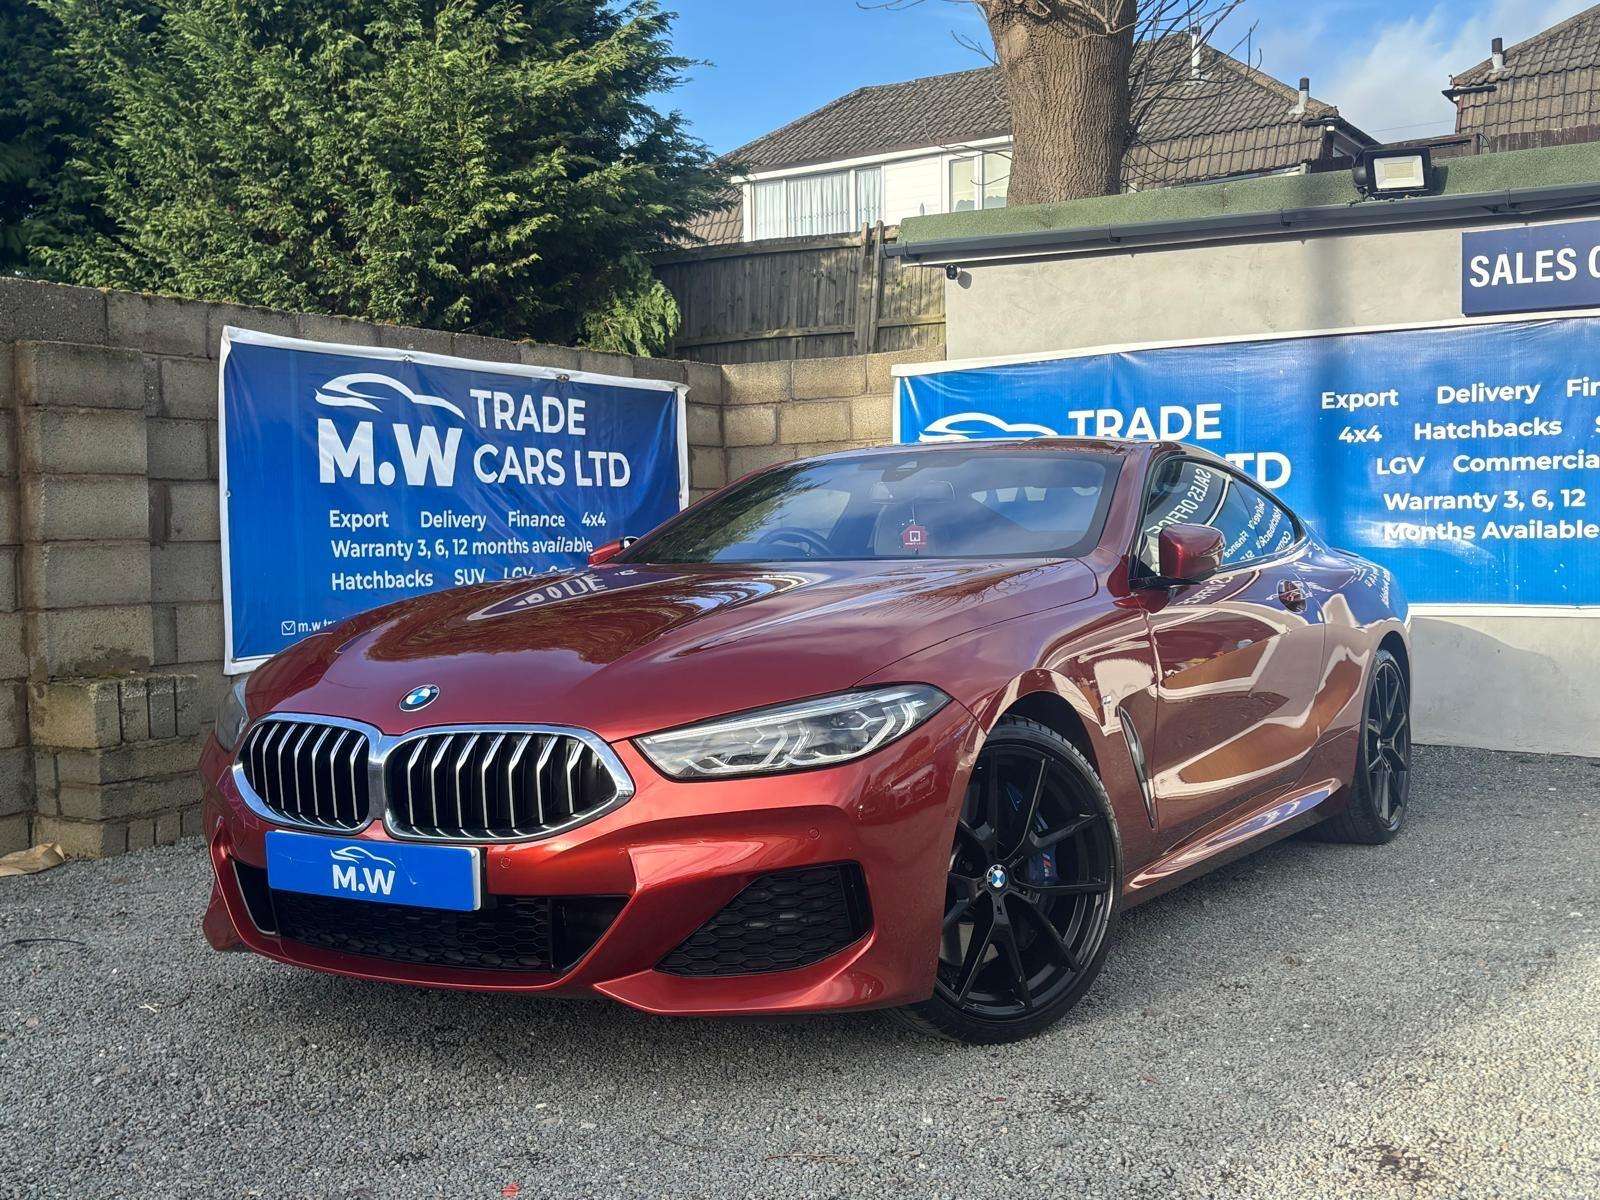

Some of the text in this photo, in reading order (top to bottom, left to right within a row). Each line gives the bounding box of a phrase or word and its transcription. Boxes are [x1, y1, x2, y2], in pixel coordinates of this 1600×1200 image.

[1469, 248, 1577, 288] SALES
[469, 388, 586, 436] TRADE
[1322, 389, 1399, 412] Export
[1437, 382, 1541, 404] Delivery
[1068, 403, 1222, 440] TRADE
[1338, 417, 1563, 443] 4x4 Hatchbacks
[317, 418, 463, 487] M.W
[473, 443, 631, 488] CARS LTD
[1376, 456, 1425, 475] LGV
[1225, 452, 1291, 490] TD
[1383, 488, 1586, 513] Warranty 3, 6, 12
[329, 509, 607, 532] Export Delivery Finance 4x4
[1384, 519, 1600, 541] Months Available
[331, 536, 593, 562] Warranty 3, 6, 12 months available
[331, 569, 434, 591] Hatchbacks
[454, 568, 486, 586] SUV
[332, 864, 396, 895] M.W
